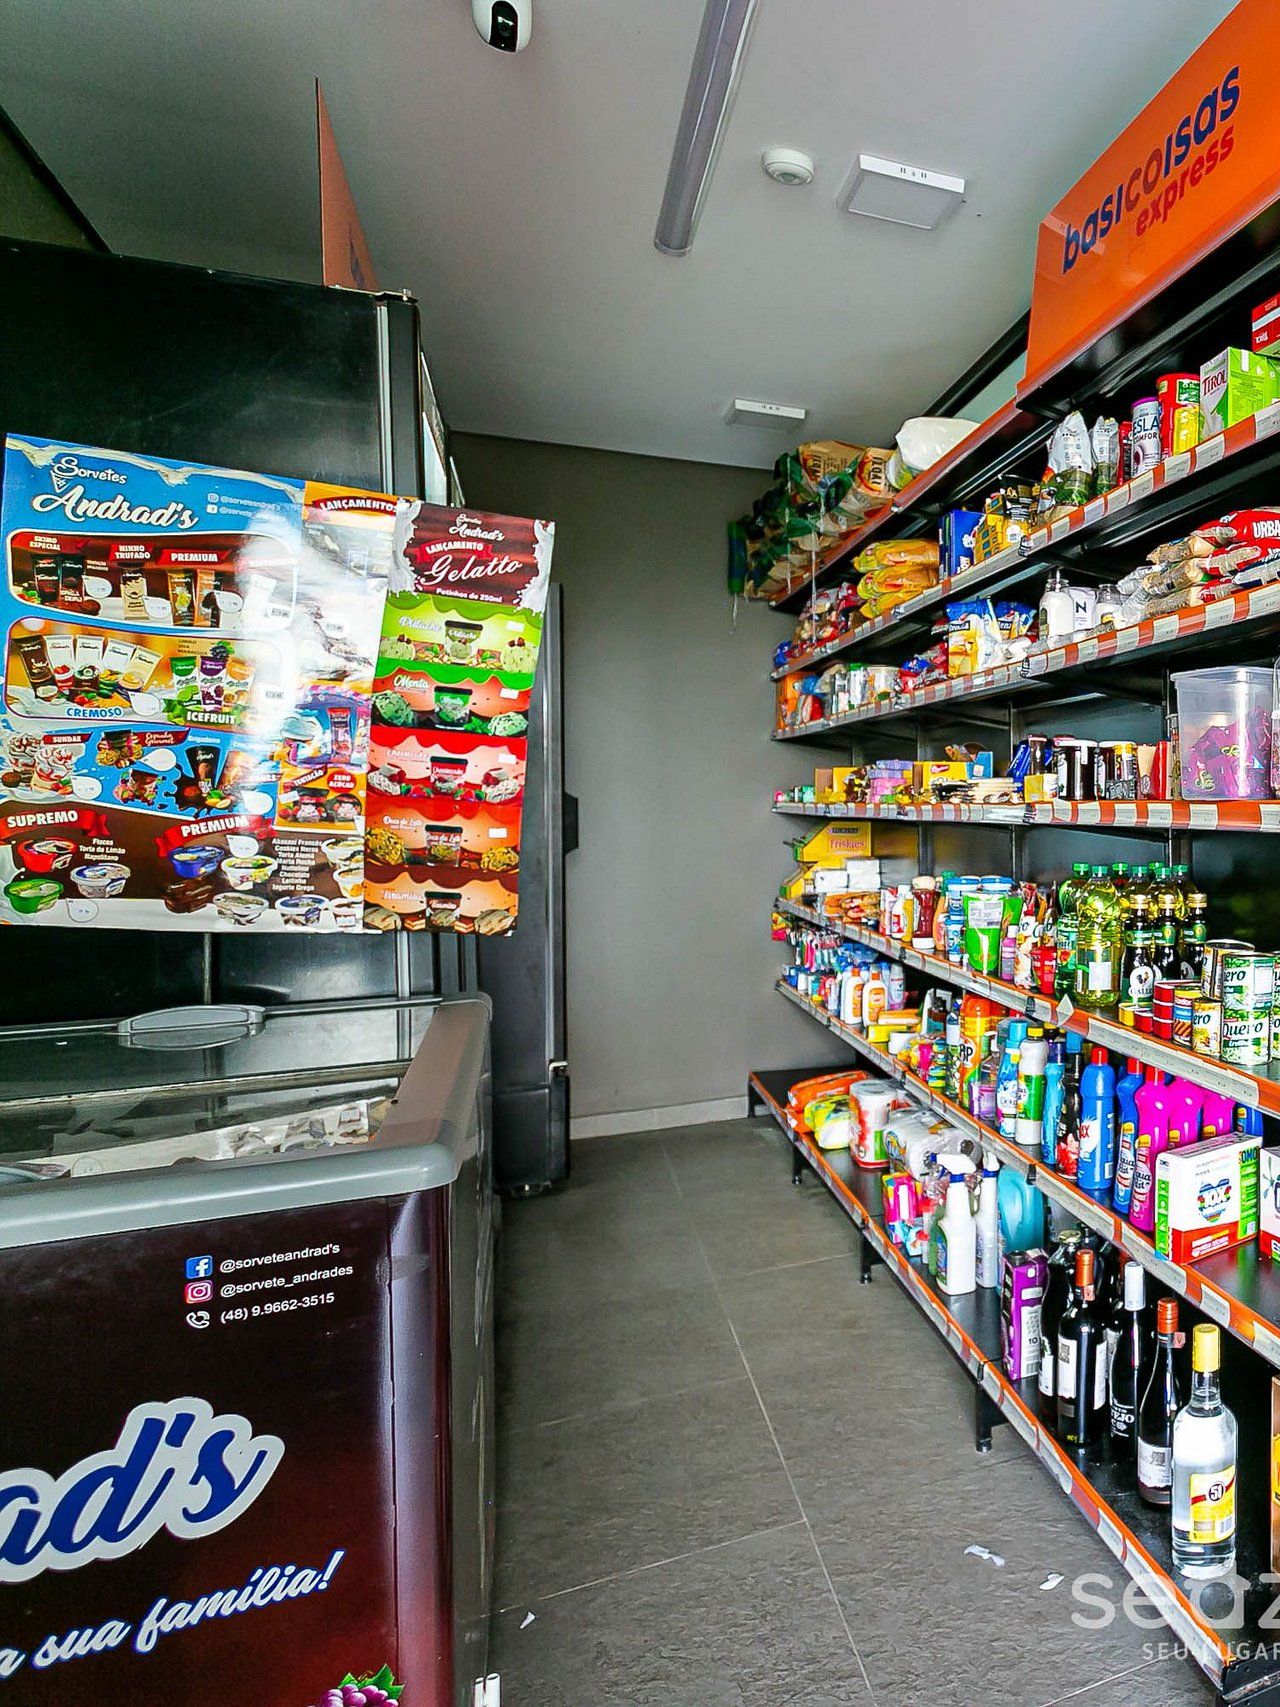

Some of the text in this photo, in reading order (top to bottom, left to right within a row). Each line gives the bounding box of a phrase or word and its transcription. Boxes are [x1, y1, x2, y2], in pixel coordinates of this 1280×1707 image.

[1135, 124, 1235, 238] express
[1202, 370, 1226, 396] TIROL
[53, 456, 127, 485] Sorvetes
[32, 485, 199, 529] Andrad's
[320, 498, 398, 512] LANÇAMENTO
[449, 523, 505, 541] Andrad's
[171, 552, 218, 562] PREMIUM
[425, 541, 484, 554] LANÇAMENTO
[420, 554, 523, 586] Gelatto
[436, 588, 468, 599] Potinhos
[469, 592, 478, 600] de
[66, 706, 123, 718] CREMOSO
[186, 710, 235, 725] ICEFRUIT
[7, 811, 78, 828] SUPREMO
[181, 814, 249, 837] PREMIUM
[1193, 1014, 1211, 1026] ero
[219, 1242, 340, 1274] @sorveteandrad's
[219, 1263, 354, 1298] @sorvete_andrades
[219, 1292, 335, 1326] (48) 9.9662-3515
[1209, 1484, 1224, 1501] 51
[32, 1549, 347, 1671] sua família!
